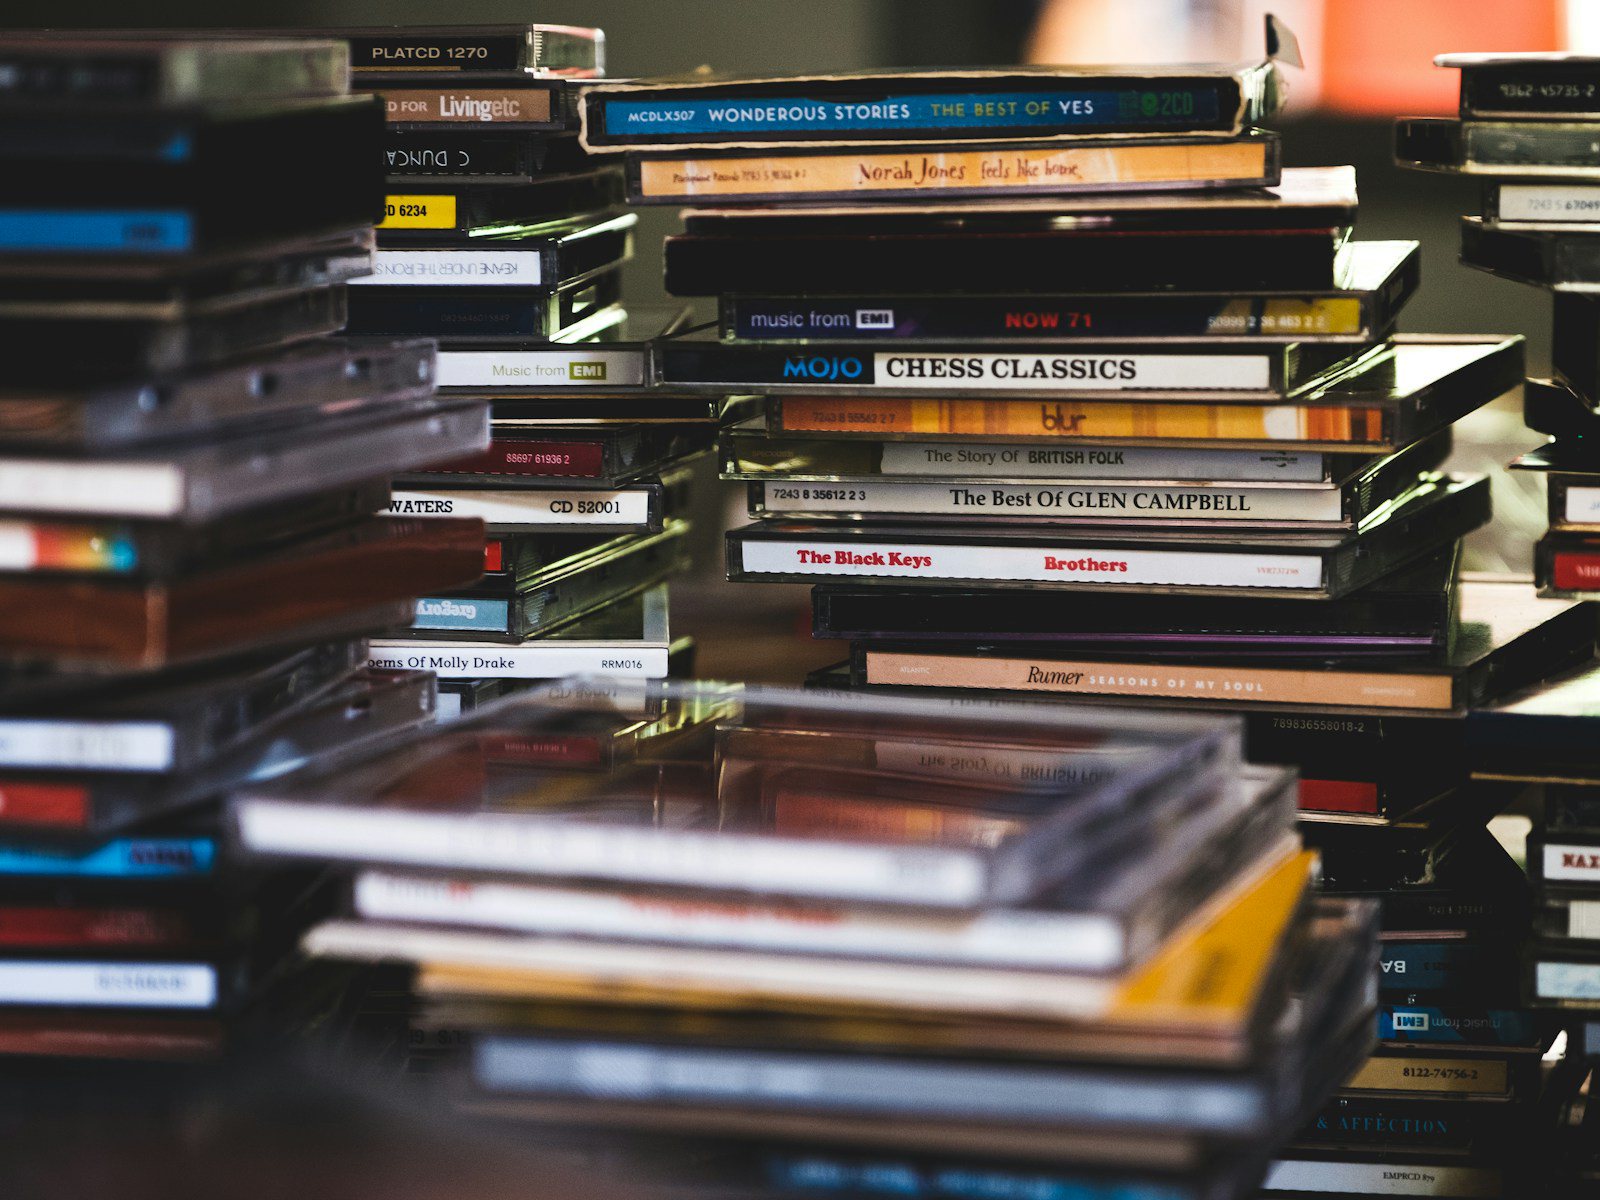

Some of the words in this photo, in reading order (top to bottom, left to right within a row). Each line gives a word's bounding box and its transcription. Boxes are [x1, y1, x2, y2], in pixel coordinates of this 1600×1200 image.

[372, 47, 440, 59] PLATCD
[446, 47, 488, 59] 1270
[385, 101, 397, 112] D
[401, 101, 427, 112] FOR
[440, 95, 520, 121] Livingetc
[628, 110, 695, 122] MCDLX507
[708, 106, 827, 122] WONDEROUS
[835, 104, 910, 120] STORIES
[931, 103, 965, 117] THE
[974, 102, 1017, 117] BEST
[1025, 101, 1050, 115] OF
[1058, 100, 1093, 115] YES
[383, 150, 447, 167] DUNCA
[459, 150, 470, 166] C
[859, 161, 913, 184] Norah
[915, 158, 967, 184] Jones
[981, 159, 1010, 179] feels
[1017, 159, 1040, 178] like
[1045, 159, 1081, 178] home
[399, 205, 427, 216] 6234
[385, 263, 414, 274] IRON
[417, 263, 436, 275] THE
[439, 263, 477, 275] UNDER
[480, 263, 518, 275] KEANE
[751, 311, 804, 327] music
[810, 310, 850, 327] from
[859, 311, 891, 327] EMI
[1005, 313, 1059, 328] NOW
[1067, 312, 1093, 328] 71
[492, 364, 531, 376] Music
[535, 364, 566, 376] from
[571, 364, 604, 378] EMI
[783, 356, 862, 380] MOJO
[886, 358, 984, 378] CHESS
[991, 358, 1137, 379] CLASSICS
[1041, 404, 1086, 433] blur
[506, 453, 532, 464] 88697
[535, 454, 561, 465] 61936
[564, 454, 570, 465] 2
[925, 450, 954, 463] The
[957, 450, 996, 466] Story
[1002, 450, 1018, 463] Of
[1028, 451, 1085, 464] BRITISH
[1089, 452, 1124, 465] FOLK
[774, 489, 799, 499] 7243
[803, 490, 810, 499] 8
[813, 490, 846, 500] 35612
[849, 491, 856, 500] 2
[859, 491, 866, 501] 3
[950, 489, 990, 506] The
[993, 490, 1031, 507] Best
[1037, 490, 1062, 507] Of
[1068, 491, 1127, 509] GLEN
[1133, 492, 1250, 512] CAMPBELL
[388, 500, 453, 513] WATERS
[550, 500, 573, 514] CD
[578, 500, 620, 514] 52001
[797, 550, 831, 564] The
[834, 551, 885, 566] Black
[888, 552, 931, 569] Keys
[1044, 556, 1128, 572] Brothers
[416, 600, 477, 619] Gregory
[407, 656, 428, 669] Of
[430, 656, 469, 671] Molly
[473, 656, 515, 669] Drake
[601, 659, 643, 669] RRM016
[1027, 666, 1084, 685] Rumer
[1089, 675, 1158, 687] SEASONS
[1167, 678, 1186, 688] OF
[1196, 680, 1215, 690] MY
[1224, 681, 1264, 693] SOUL
[1272, 718, 1365, 733] 789836558018-2
[1394, 1014, 1427, 1029] EMI
[1431, 1017, 1460, 1029] from
[1463, 1018, 1500, 1030] music
[1403, 1067, 1478, 1080] 8122-74756-2
[1317, 1116, 1328, 1130] &
[1340, 1117, 1448, 1134] AFFECTION
[1383, 1171, 1420, 1181] EMPRCD
[1422, 1173, 1435, 1183] 879
